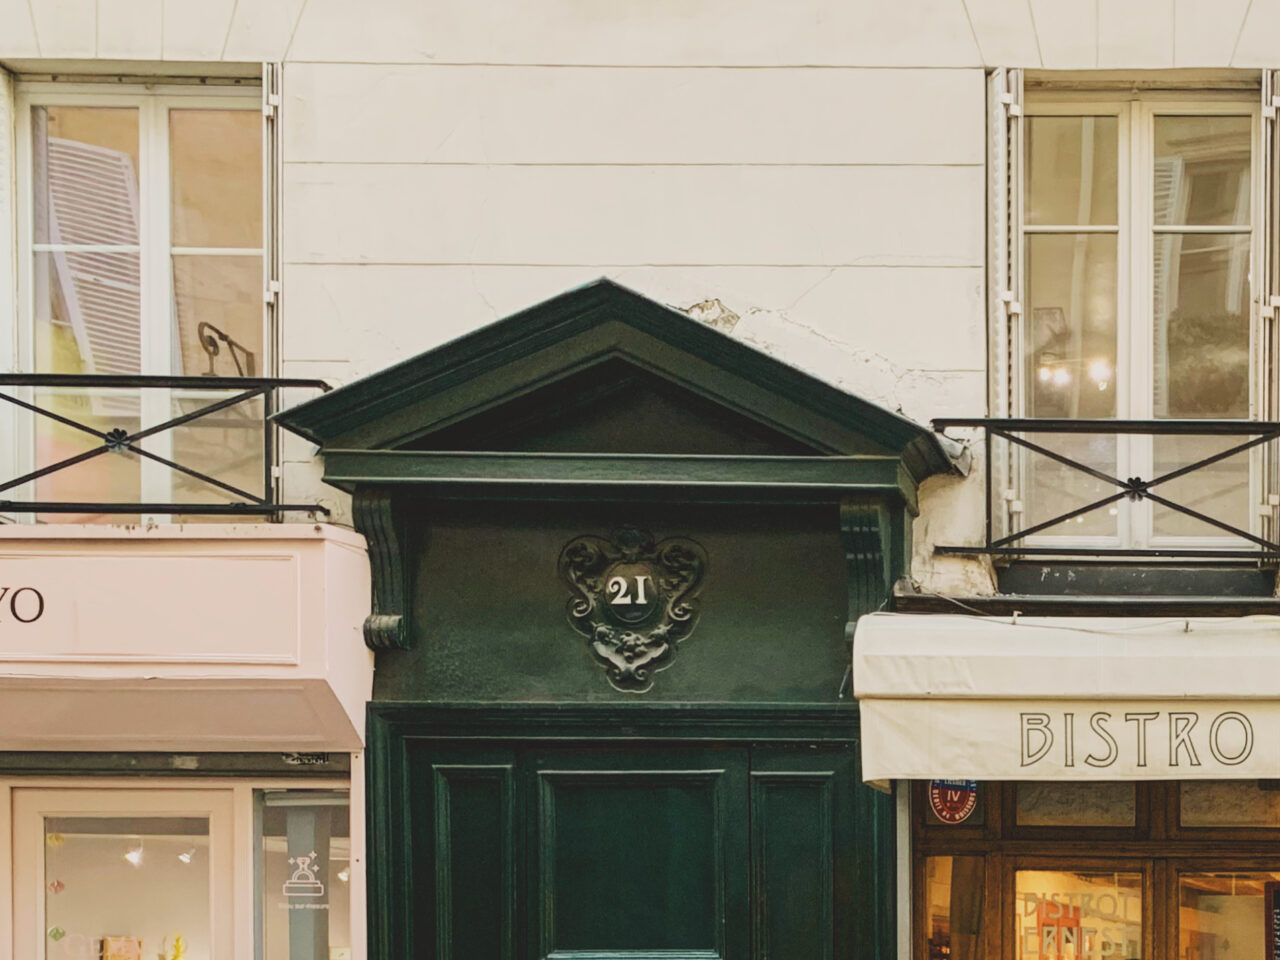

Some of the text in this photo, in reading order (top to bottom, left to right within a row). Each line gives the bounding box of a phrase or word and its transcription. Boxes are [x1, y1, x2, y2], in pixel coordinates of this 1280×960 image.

[609, 576, 648, 605] 21
[1019, 711, 1254, 767] BISTRO
[1024, 926, 1134, 956] ERNEST
